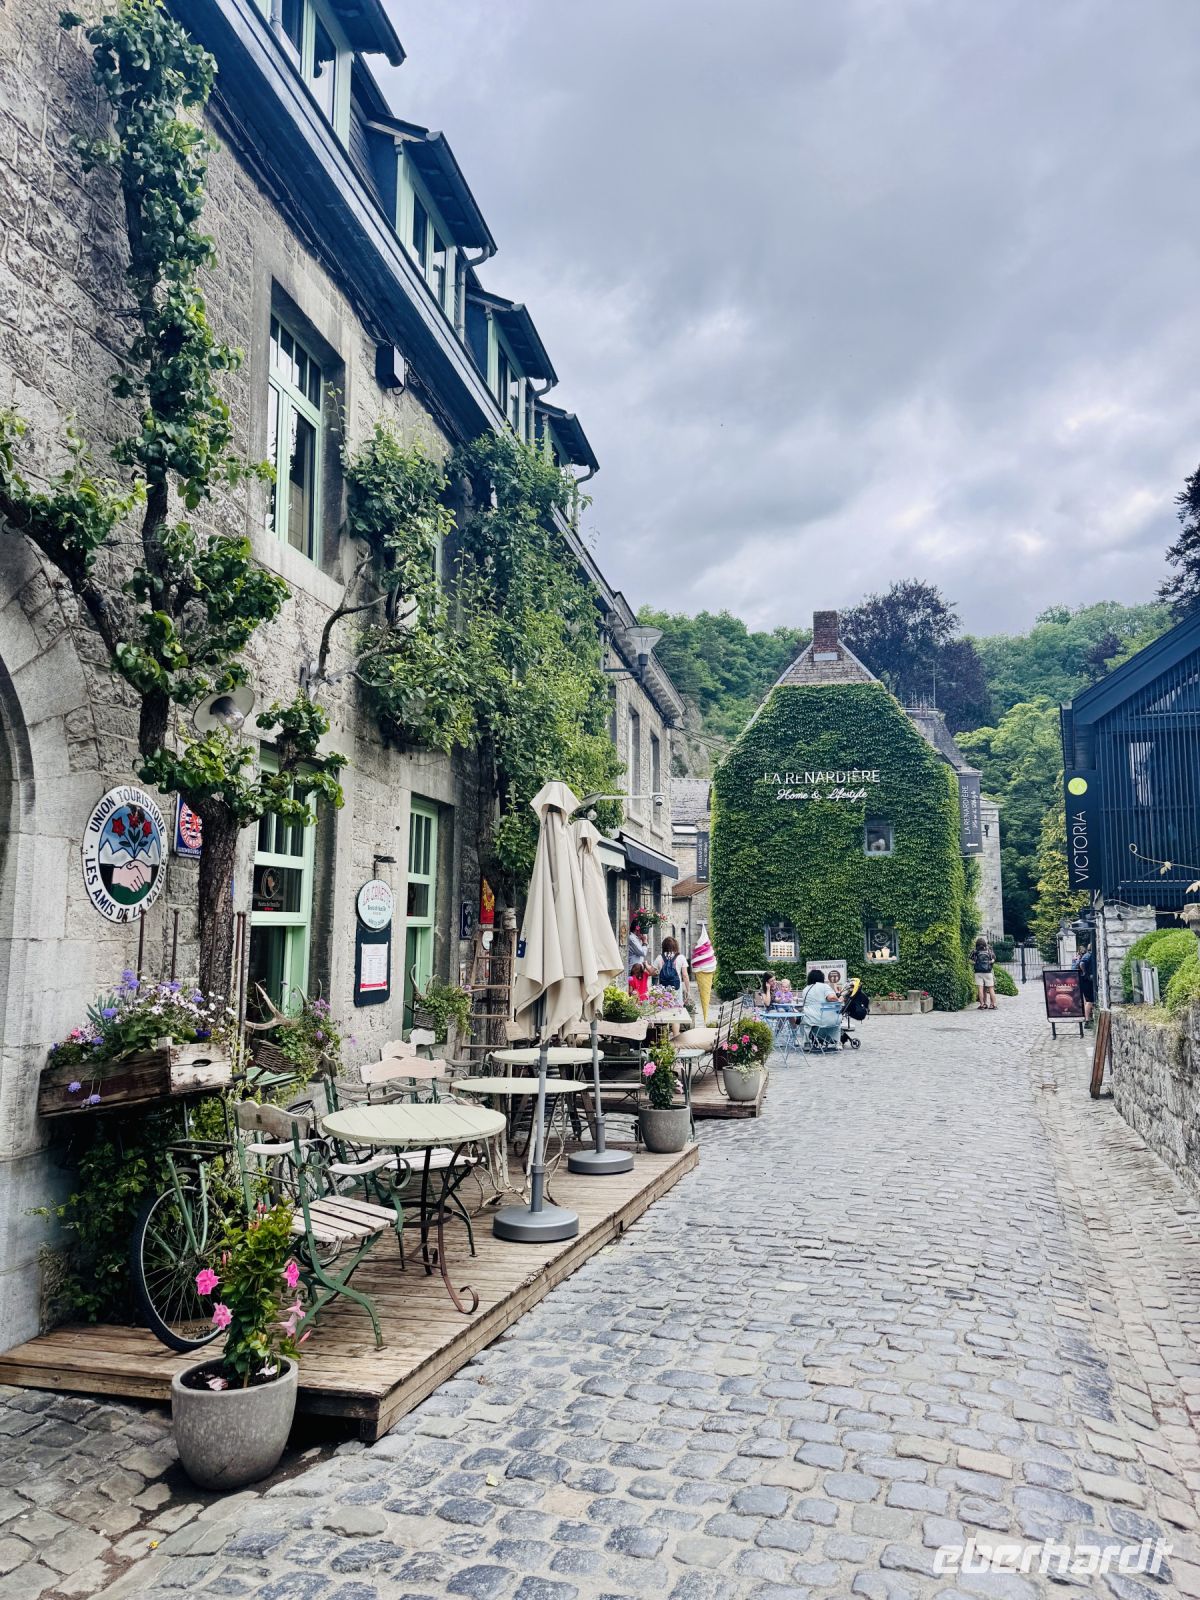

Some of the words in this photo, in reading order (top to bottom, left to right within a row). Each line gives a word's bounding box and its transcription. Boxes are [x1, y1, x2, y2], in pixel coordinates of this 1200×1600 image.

[764, 772, 782, 785] LA
[785, 767, 881, 785] RENARDIÈRE
[776, 788, 808, 800] Home
[811, 790, 822, 800] &
[827, 787, 869, 803] Lifestyle
[89, 795, 117, 833] UNION
[117, 788, 166, 837] TOURISTIQUE
[962, 785, 971, 825] RENARDIÈRE
[1072, 810, 1090, 883] VICTORIA
[85, 858, 99, 886] LES
[92, 889, 116, 917] AMIS
[116, 907, 130, 920] DE
[146, 857, 167, 908] NATURE
